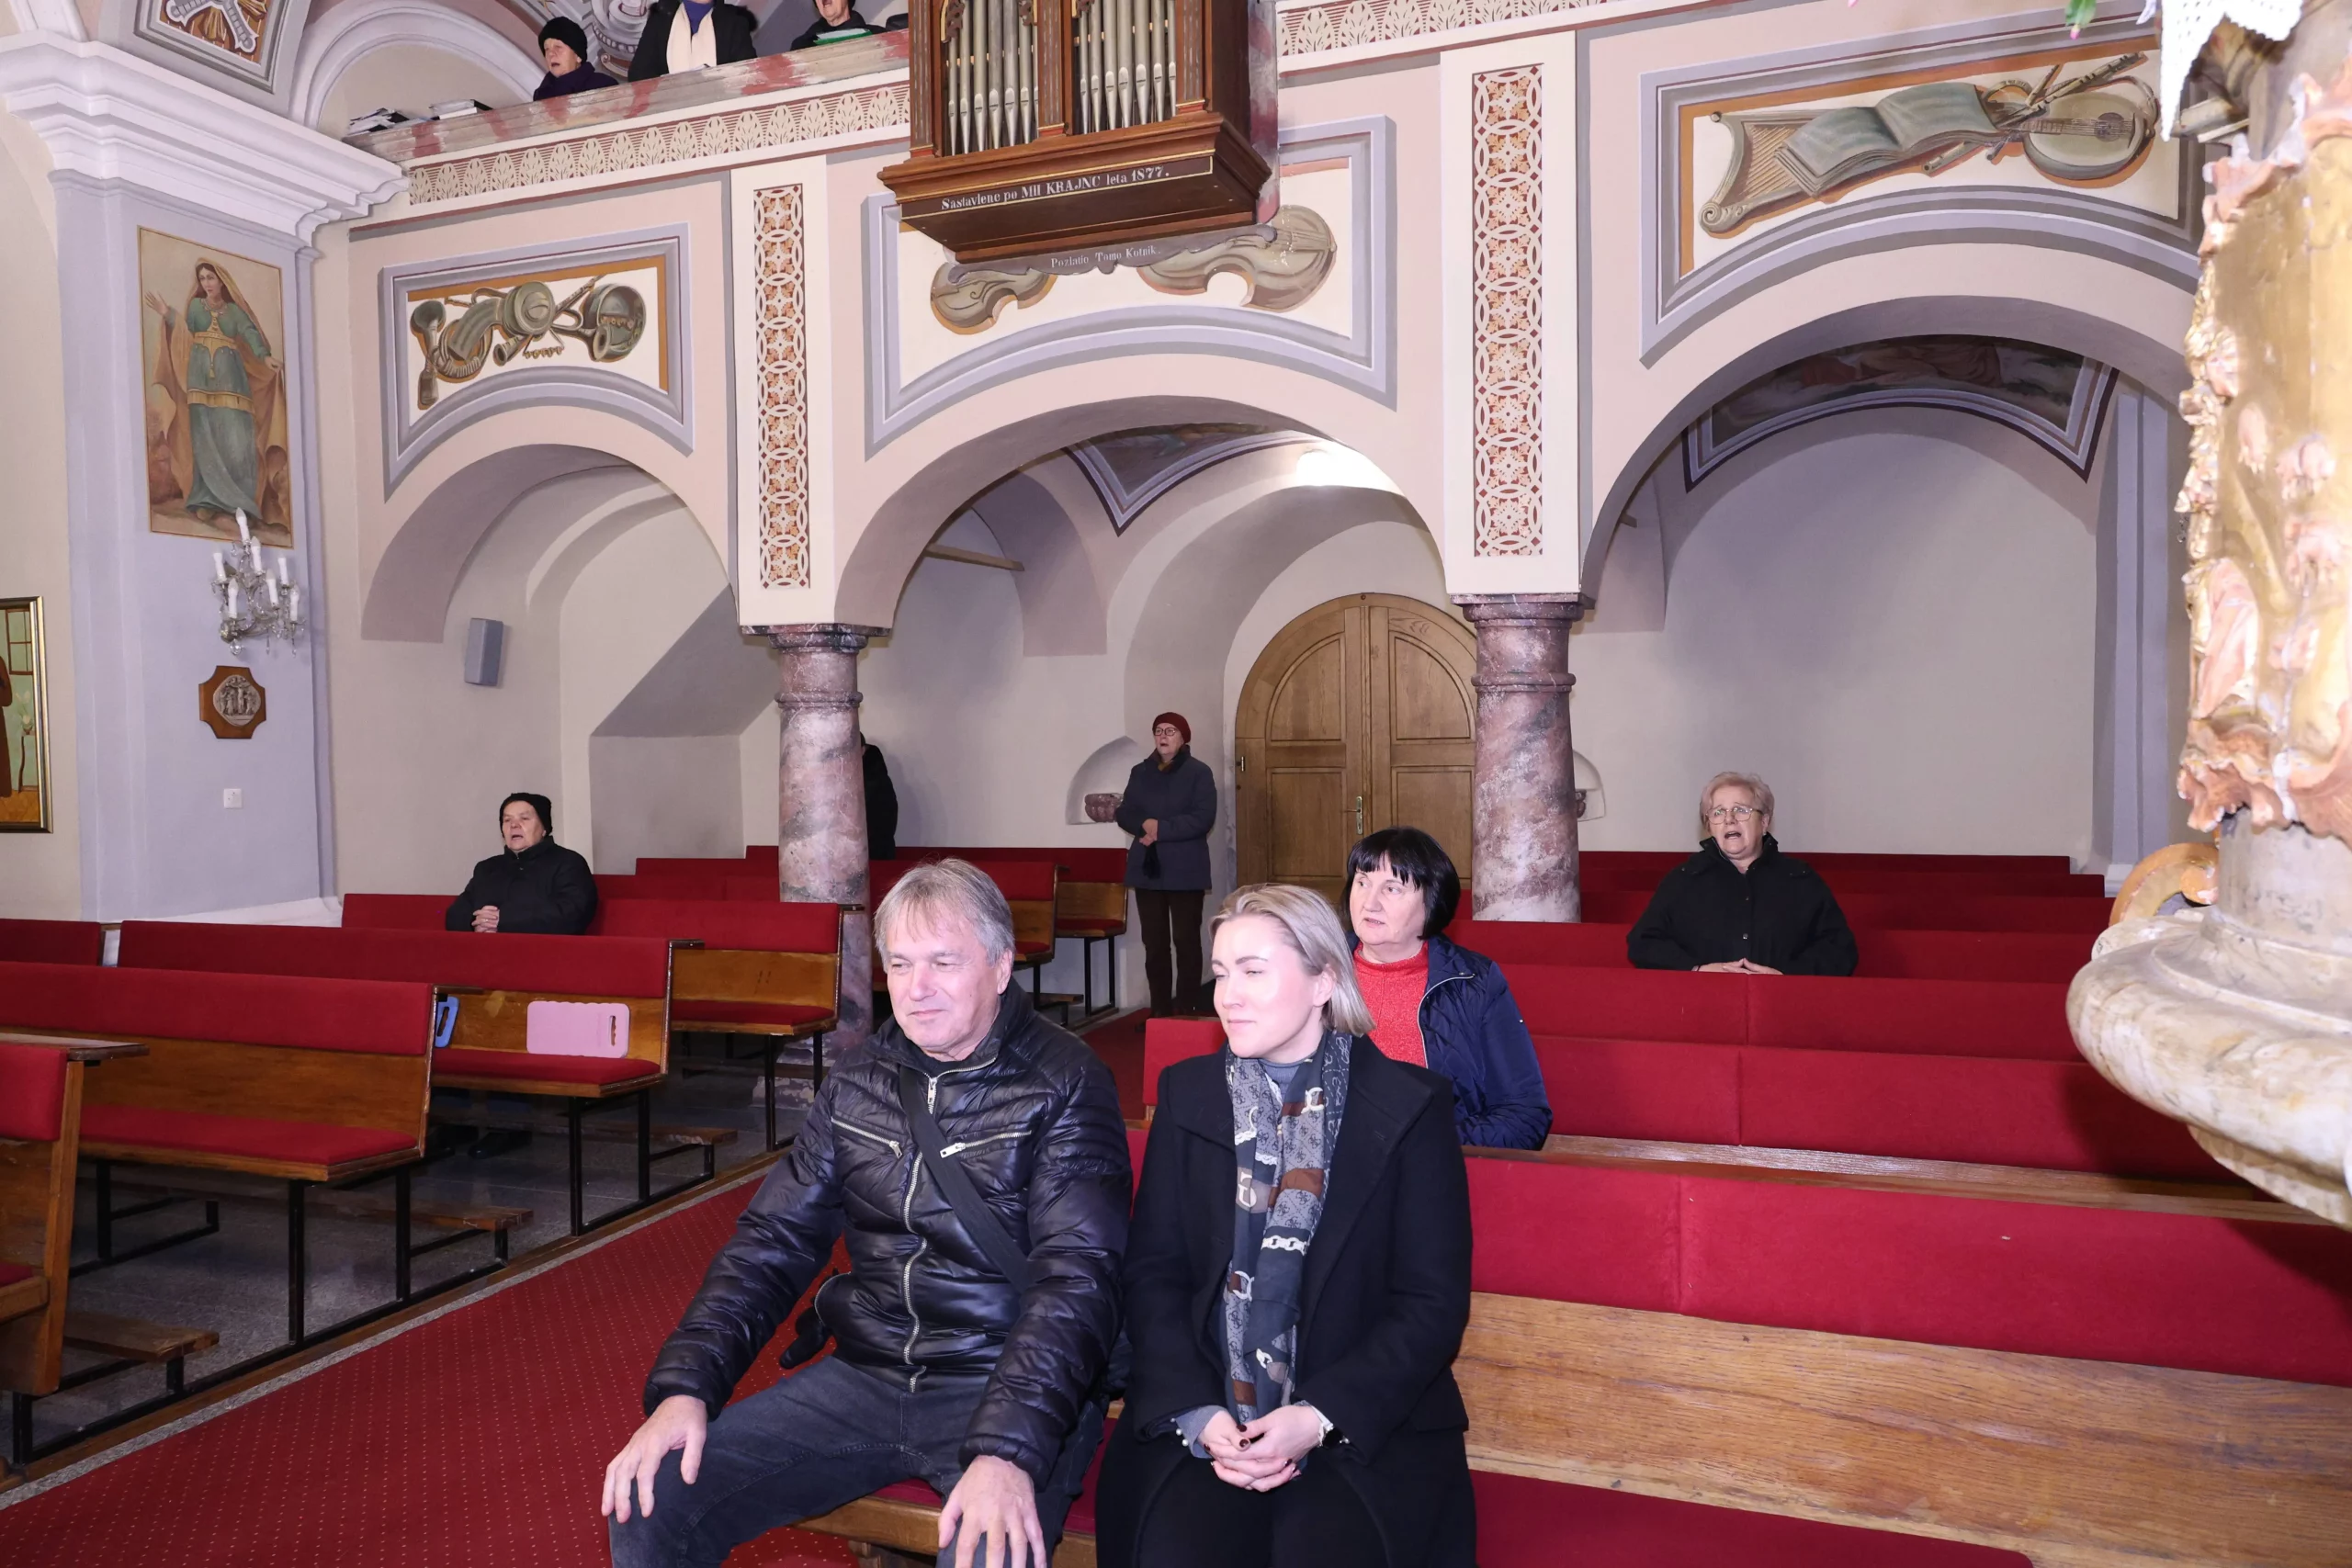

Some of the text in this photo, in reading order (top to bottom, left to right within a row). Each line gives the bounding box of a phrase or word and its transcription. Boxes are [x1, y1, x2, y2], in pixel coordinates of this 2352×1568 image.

[1003, 190, 1018, 203] po
[1046, 175, 1101, 195] KRAJNC
[1106, 174, 1127, 186] leta
[1131, 165, 1170, 182] 1877.
[1051, 254, 1089, 268] Pozlatio
[1095, 251, 1122, 263] Tomo
